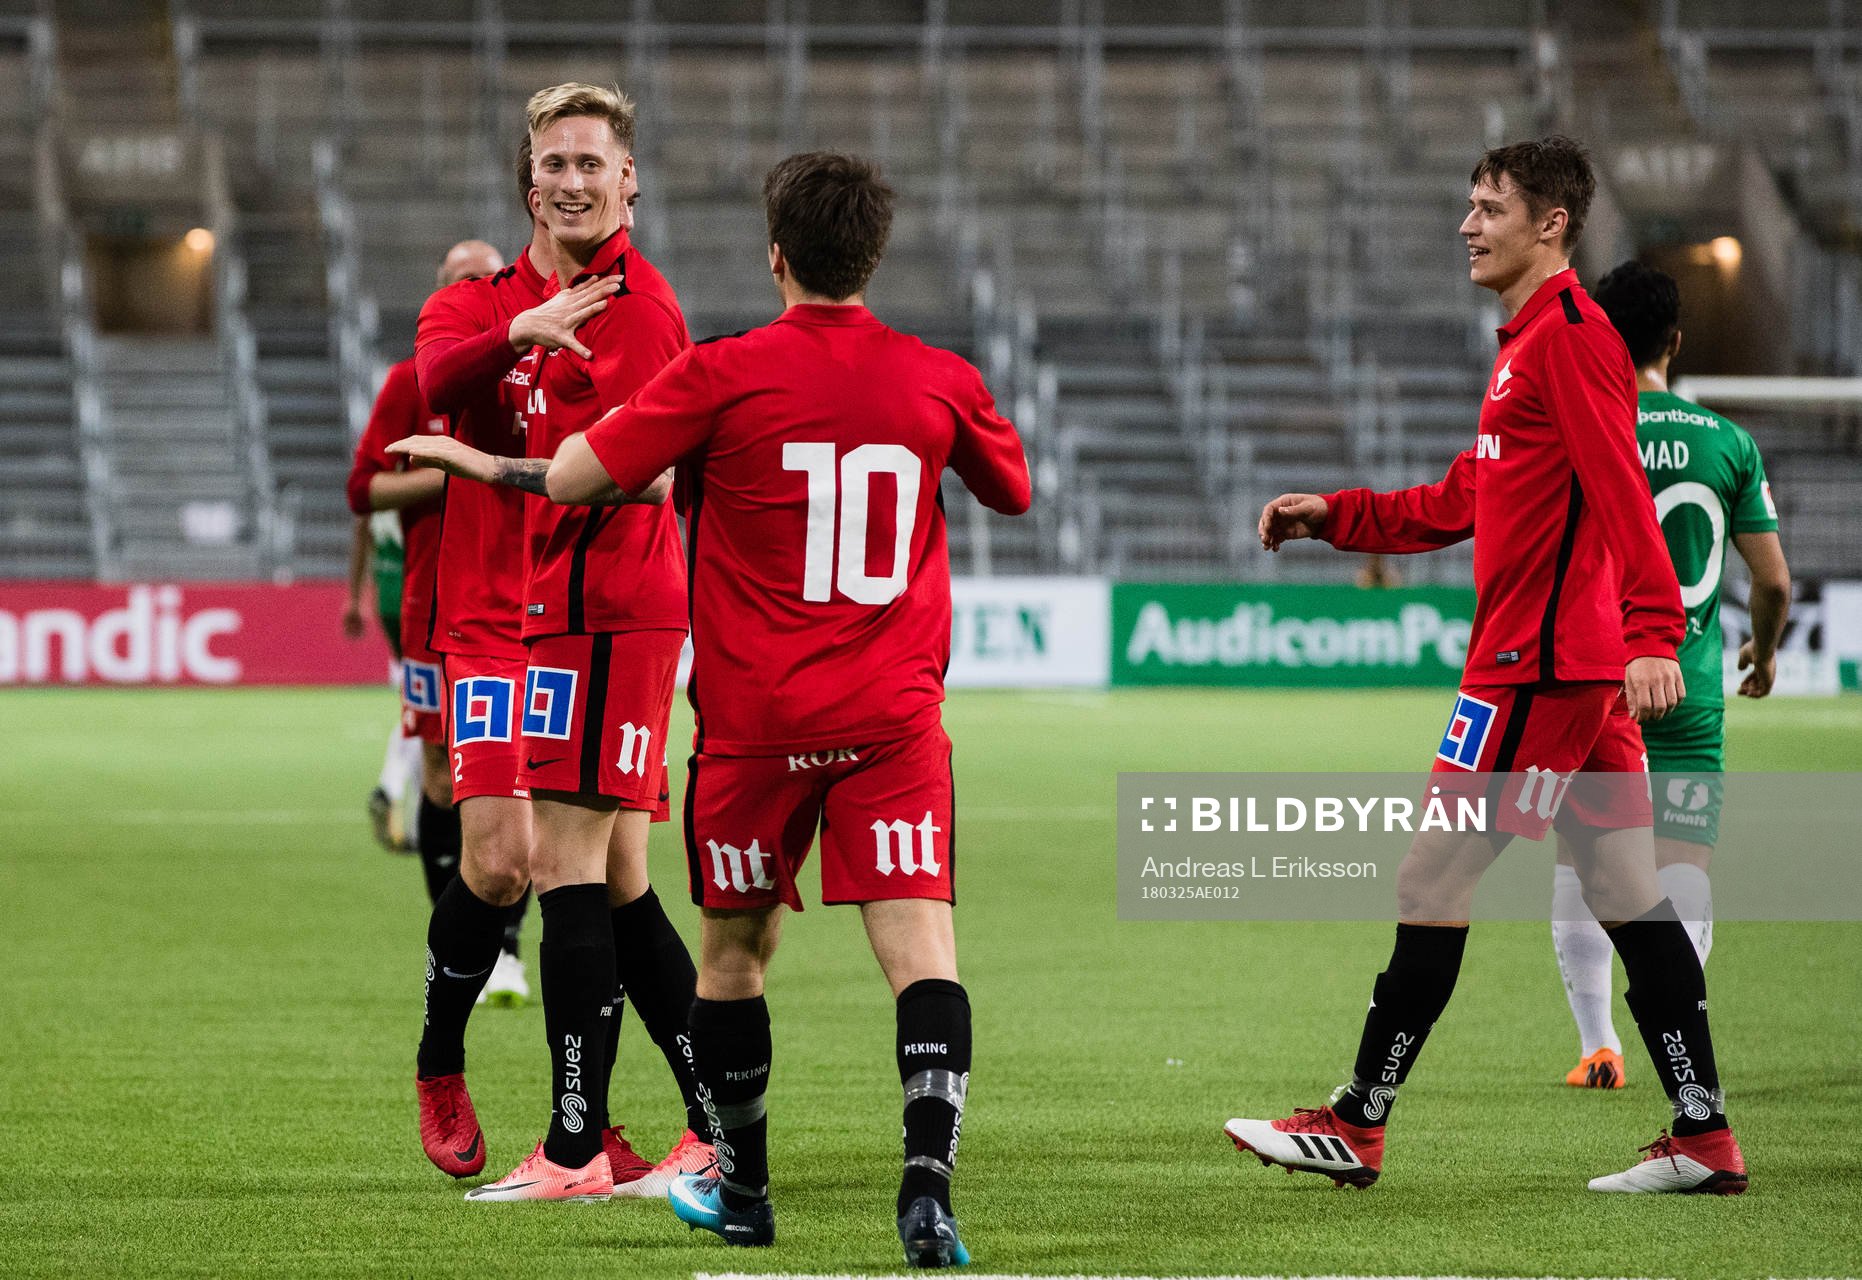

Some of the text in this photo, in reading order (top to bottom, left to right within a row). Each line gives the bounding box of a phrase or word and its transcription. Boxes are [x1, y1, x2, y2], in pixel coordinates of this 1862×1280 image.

[1637, 408, 1720, 430] pantbank
[1636, 440, 1690, 470] MAD
[782, 442, 922, 605] 10
[952, 602, 1052, 661] EN
[706, 838, 777, 894] nt
[870, 810, 942, 878] nt
[565, 1033, 583, 1092] suez
[725, 1062, 769, 1081] PEKING
[904, 1042, 948, 1057] PEKING
[1381, 1031, 1416, 1084] suez
